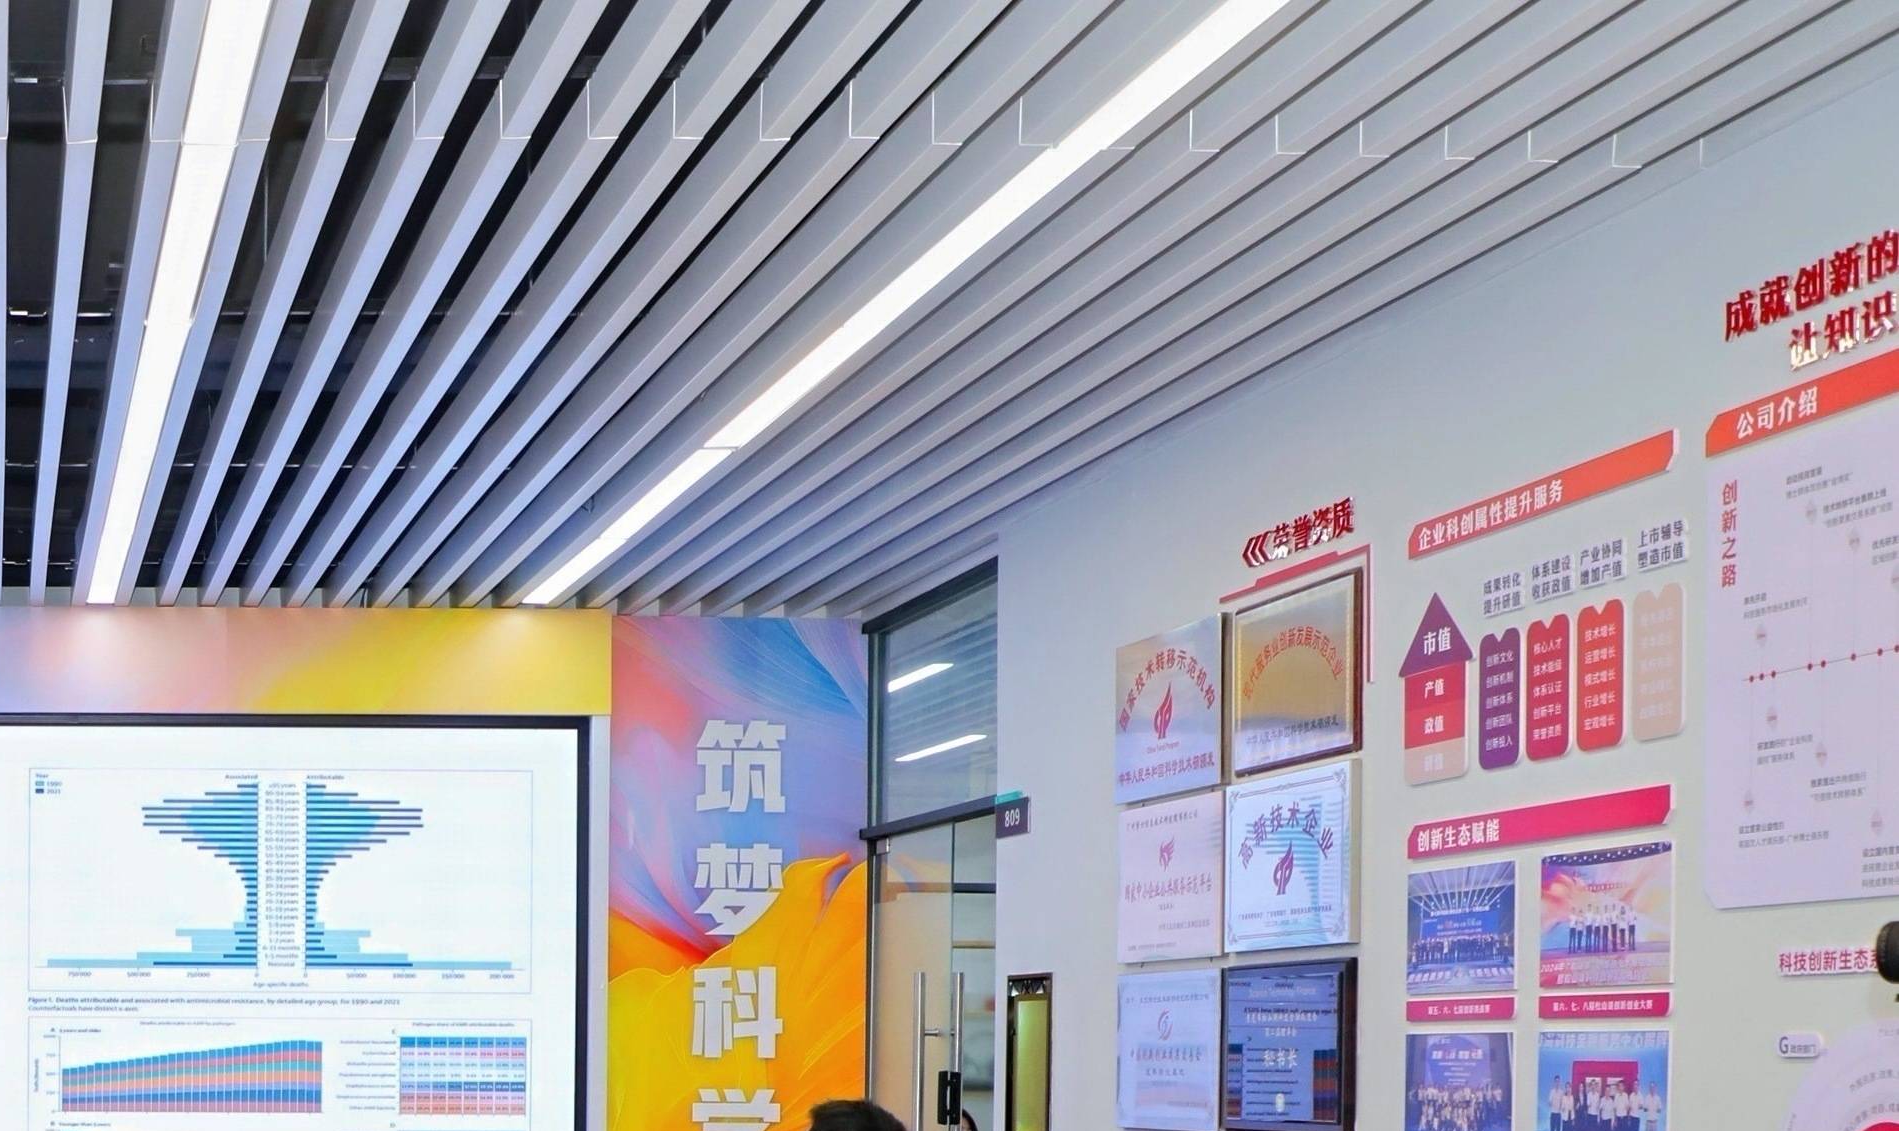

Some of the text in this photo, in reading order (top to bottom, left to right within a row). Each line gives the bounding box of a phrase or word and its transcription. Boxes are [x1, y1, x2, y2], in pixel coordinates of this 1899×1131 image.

[1724, 229, 1899, 343] 成就创新的
[1736, 386, 1818, 440] 公司介绍
[1417, 479, 1563, 551] 企业科创属性提升服务
[1637, 520, 1684, 548] 上市辅导
[1720, 479, 1739, 589] 创新之路
[1580, 538, 1622, 564] 产业协同
[1637, 541, 1684, 569] 塑造市值
[1531, 555, 1571, 579] 体系建设
[1580, 560, 1622, 586] 增加产值
[1483, 572, 1522, 597] 成果转化
[1423, 626, 1451, 656] 市值
[1424, 679, 1444, 699] 产值
[1004, 808, 1020, 828] 809
[1238, 801, 1334, 869] 高新技术企业
[1417, 818, 1500, 852] 创新生态赋能
[1779, 1036, 1789, 1054] G
